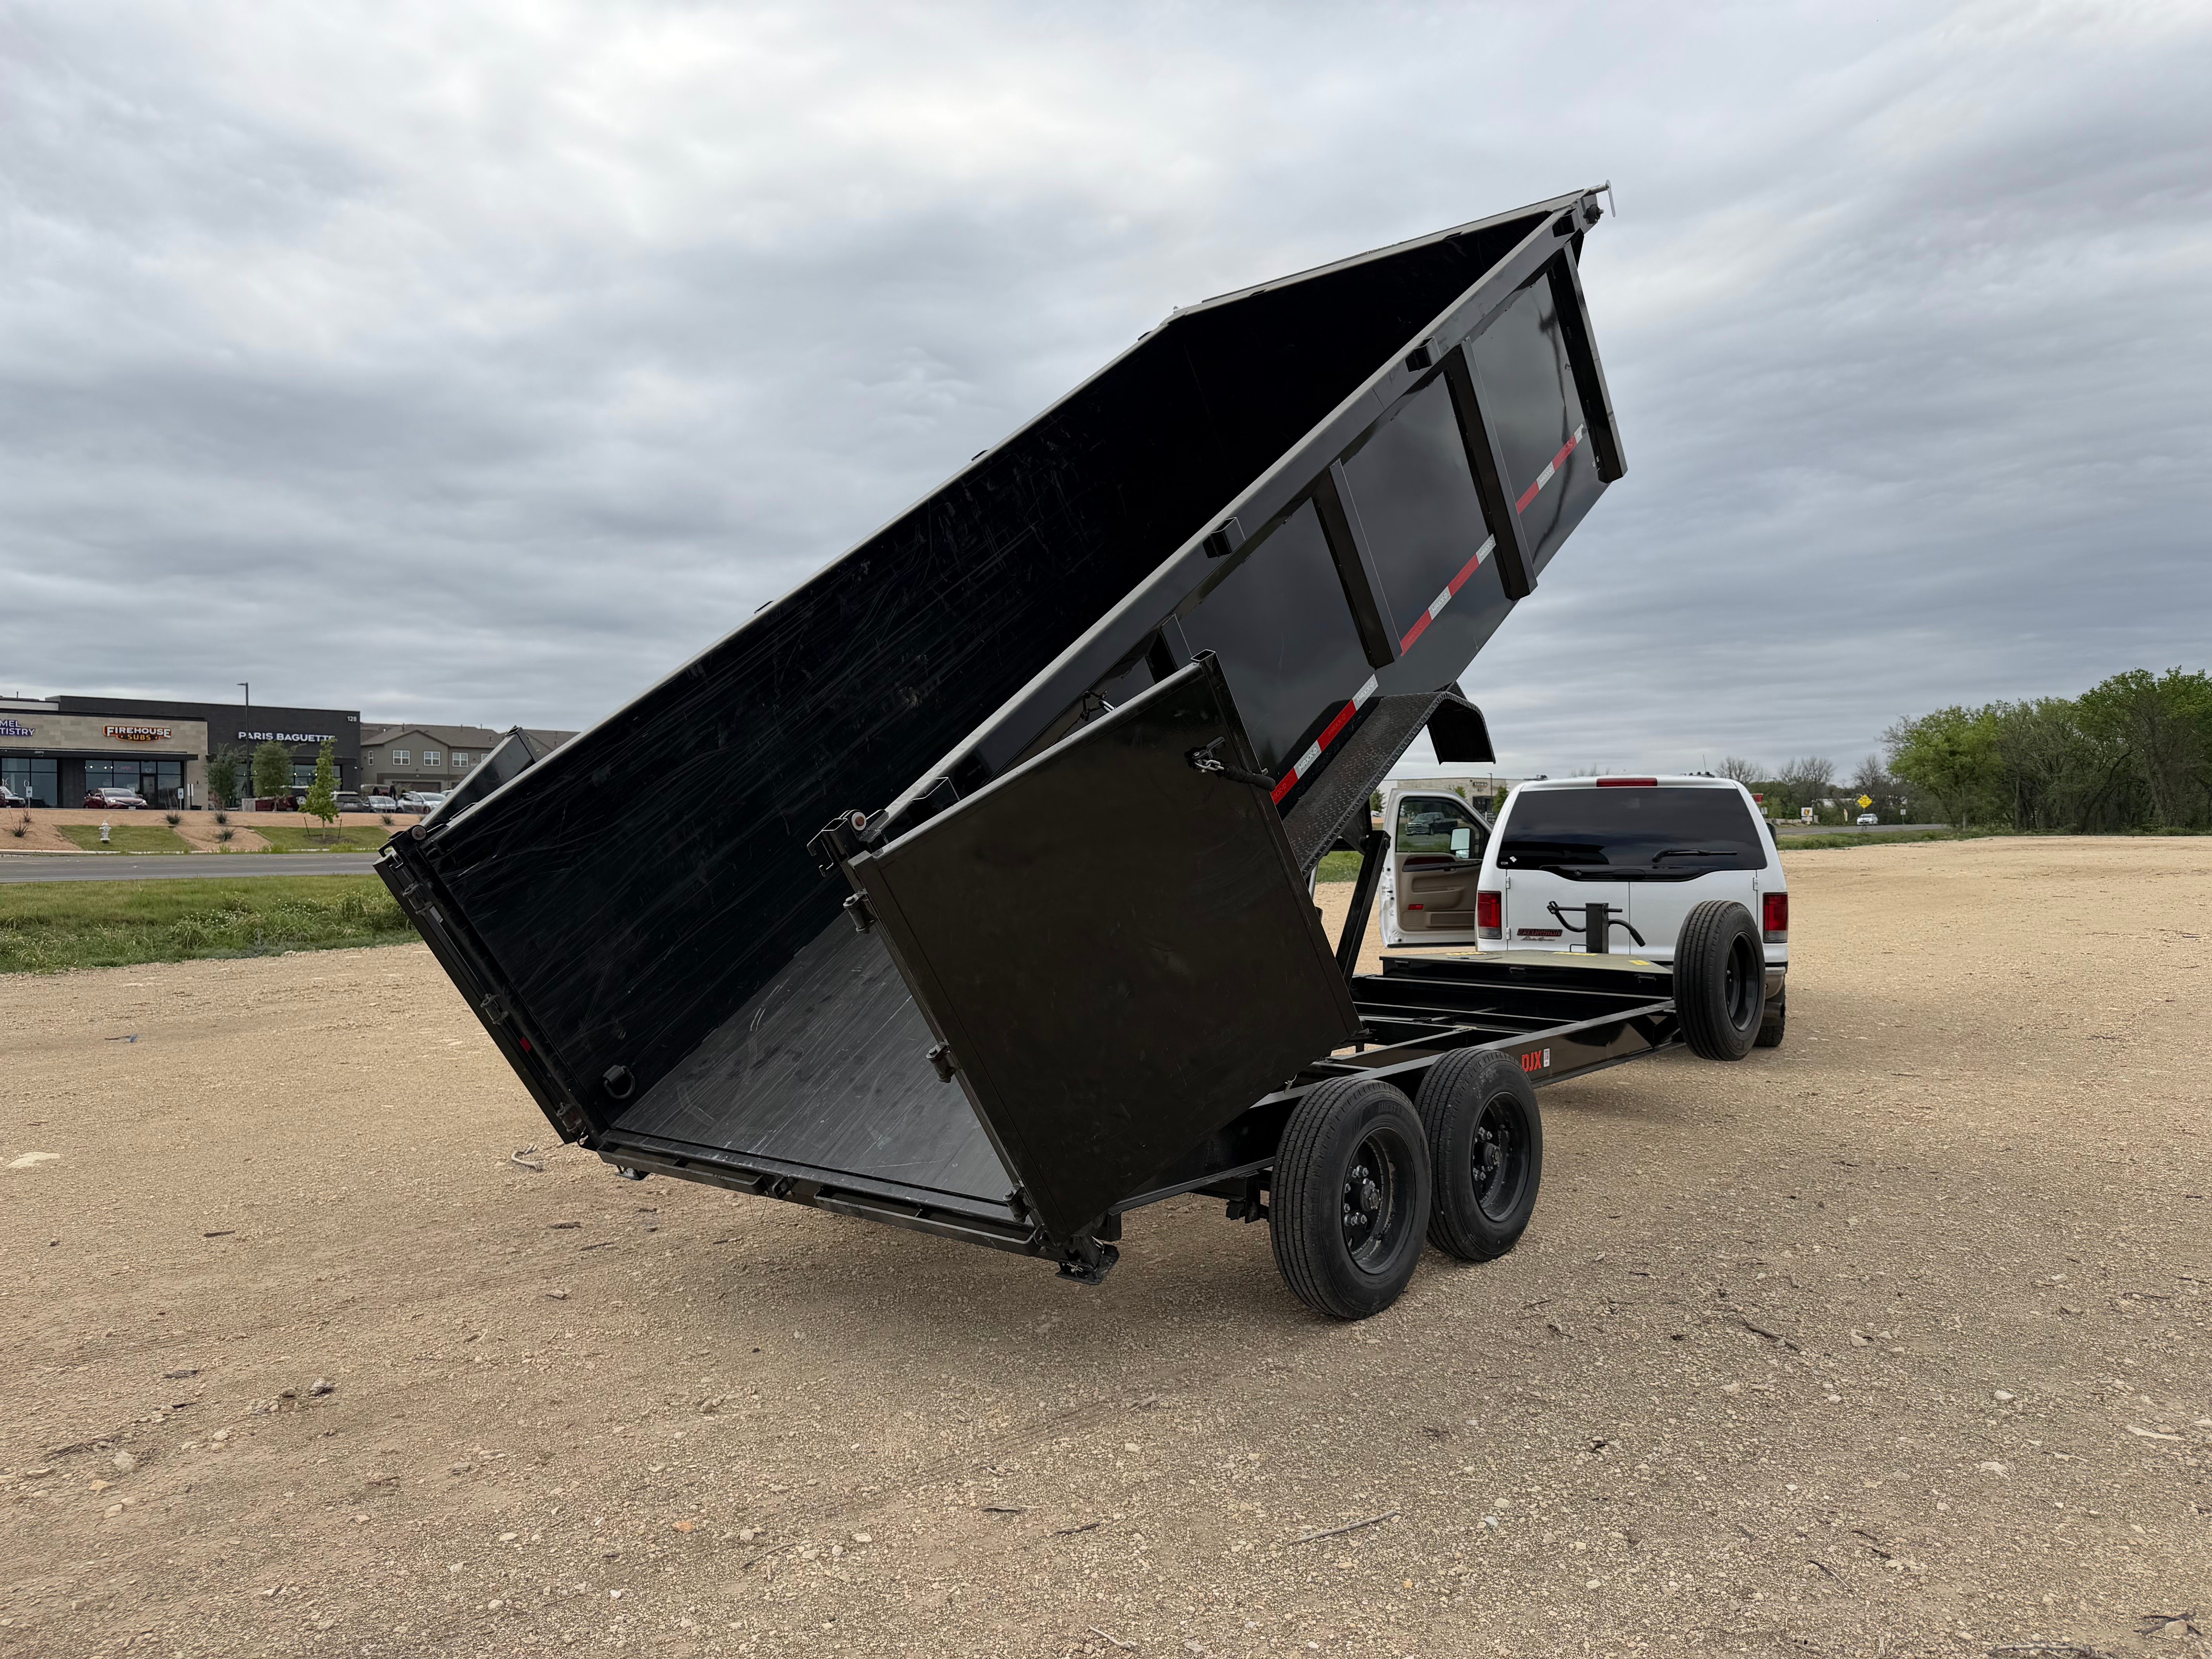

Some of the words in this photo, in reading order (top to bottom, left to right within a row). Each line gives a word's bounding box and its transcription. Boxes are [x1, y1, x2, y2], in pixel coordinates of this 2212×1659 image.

[107, 726, 171, 738] FIREHOUSE
[238, 732, 273, 740] PARIS
[1298, 747, 1317, 771] MAXX-D
[1522, 1050, 1542, 1072] DJX
